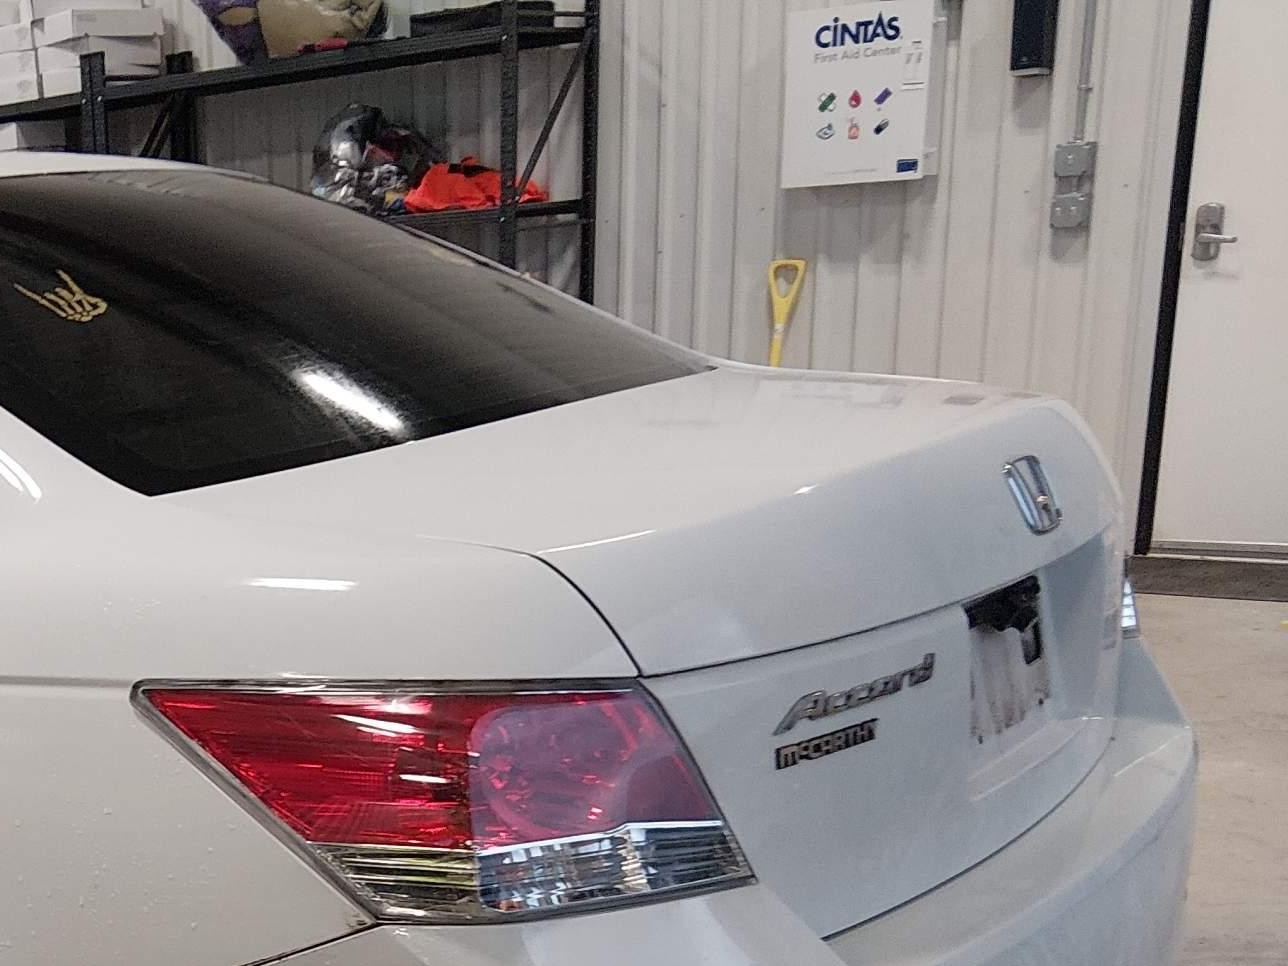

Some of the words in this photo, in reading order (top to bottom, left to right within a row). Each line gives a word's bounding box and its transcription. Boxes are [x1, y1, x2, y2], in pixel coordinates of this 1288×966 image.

[814, 52, 838, 64] First
[841, 49, 860, 60] Aid
[863, 46, 902, 58] Center
[772, 652, 936, 736] Accord
